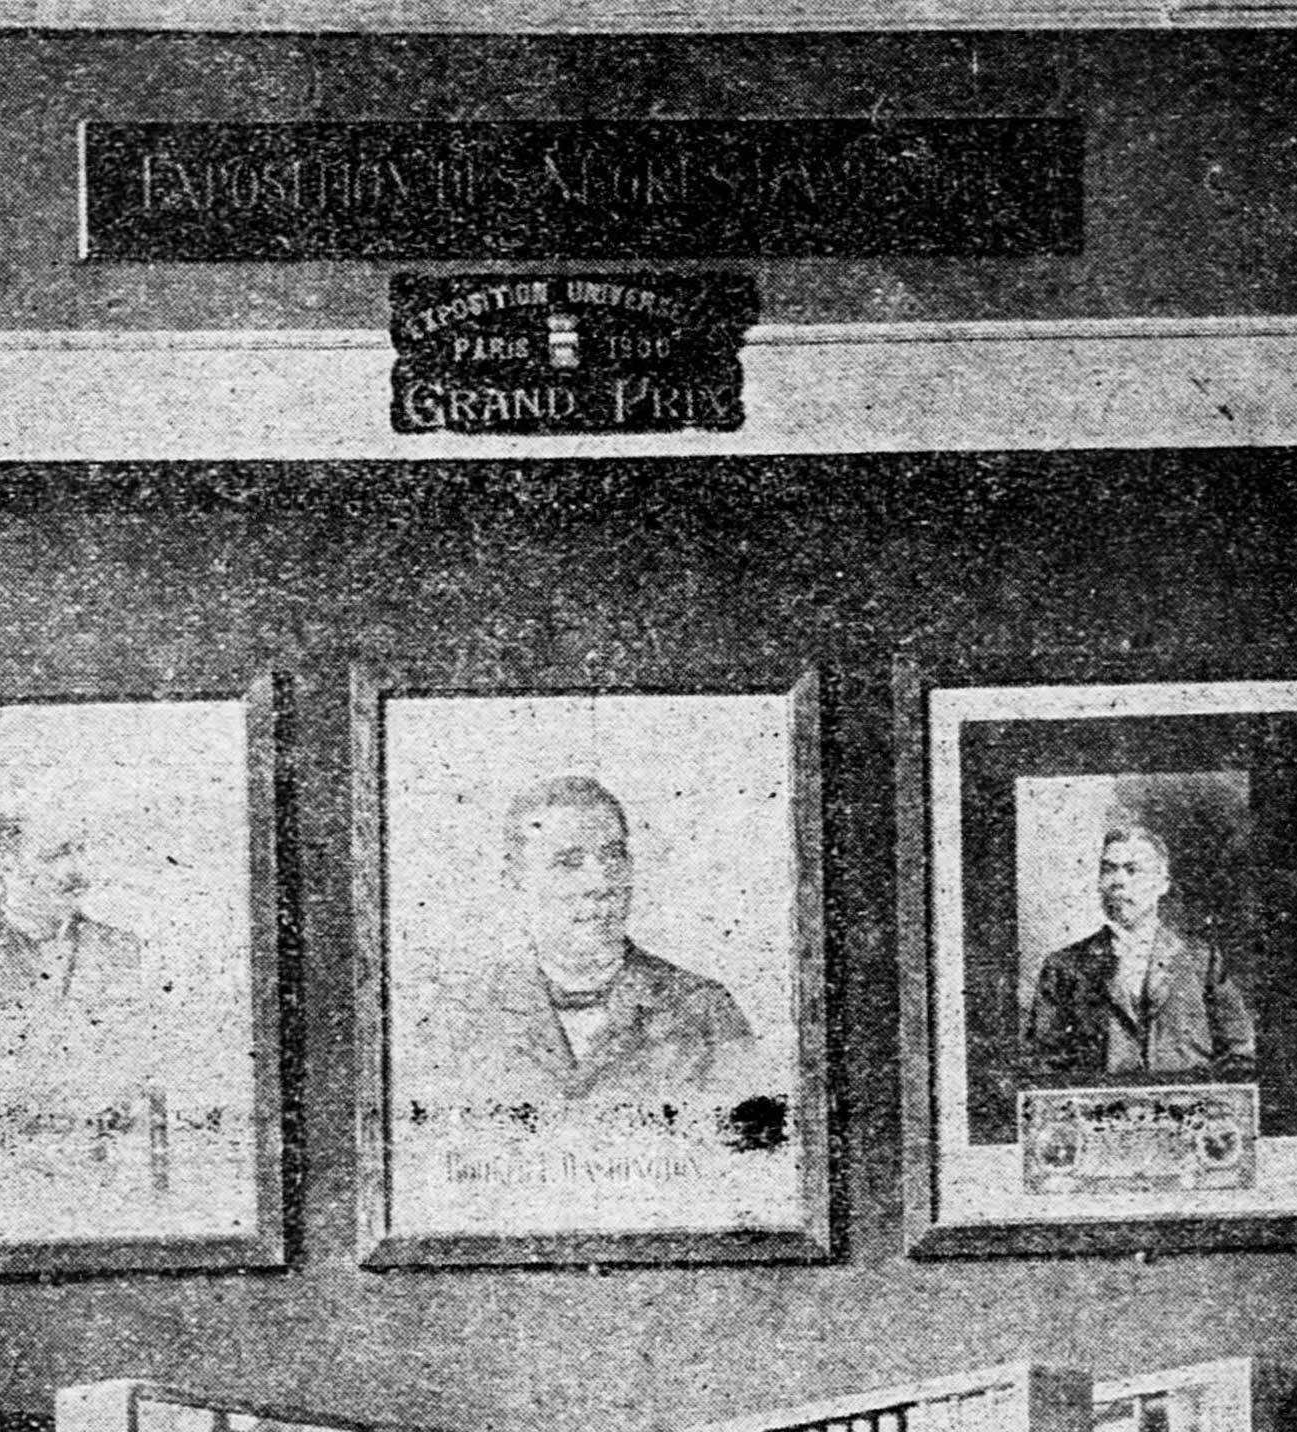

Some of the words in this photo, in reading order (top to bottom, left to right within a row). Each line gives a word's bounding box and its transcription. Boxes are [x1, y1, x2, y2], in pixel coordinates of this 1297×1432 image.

[404, 281, 550, 341] EXPOSITION
[453, 334, 530, 363] PARIS
[607, 335, 671, 361] 1900
[405, 380, 577, 428] GRAND
[614, 376, 731, 426] PRIX
